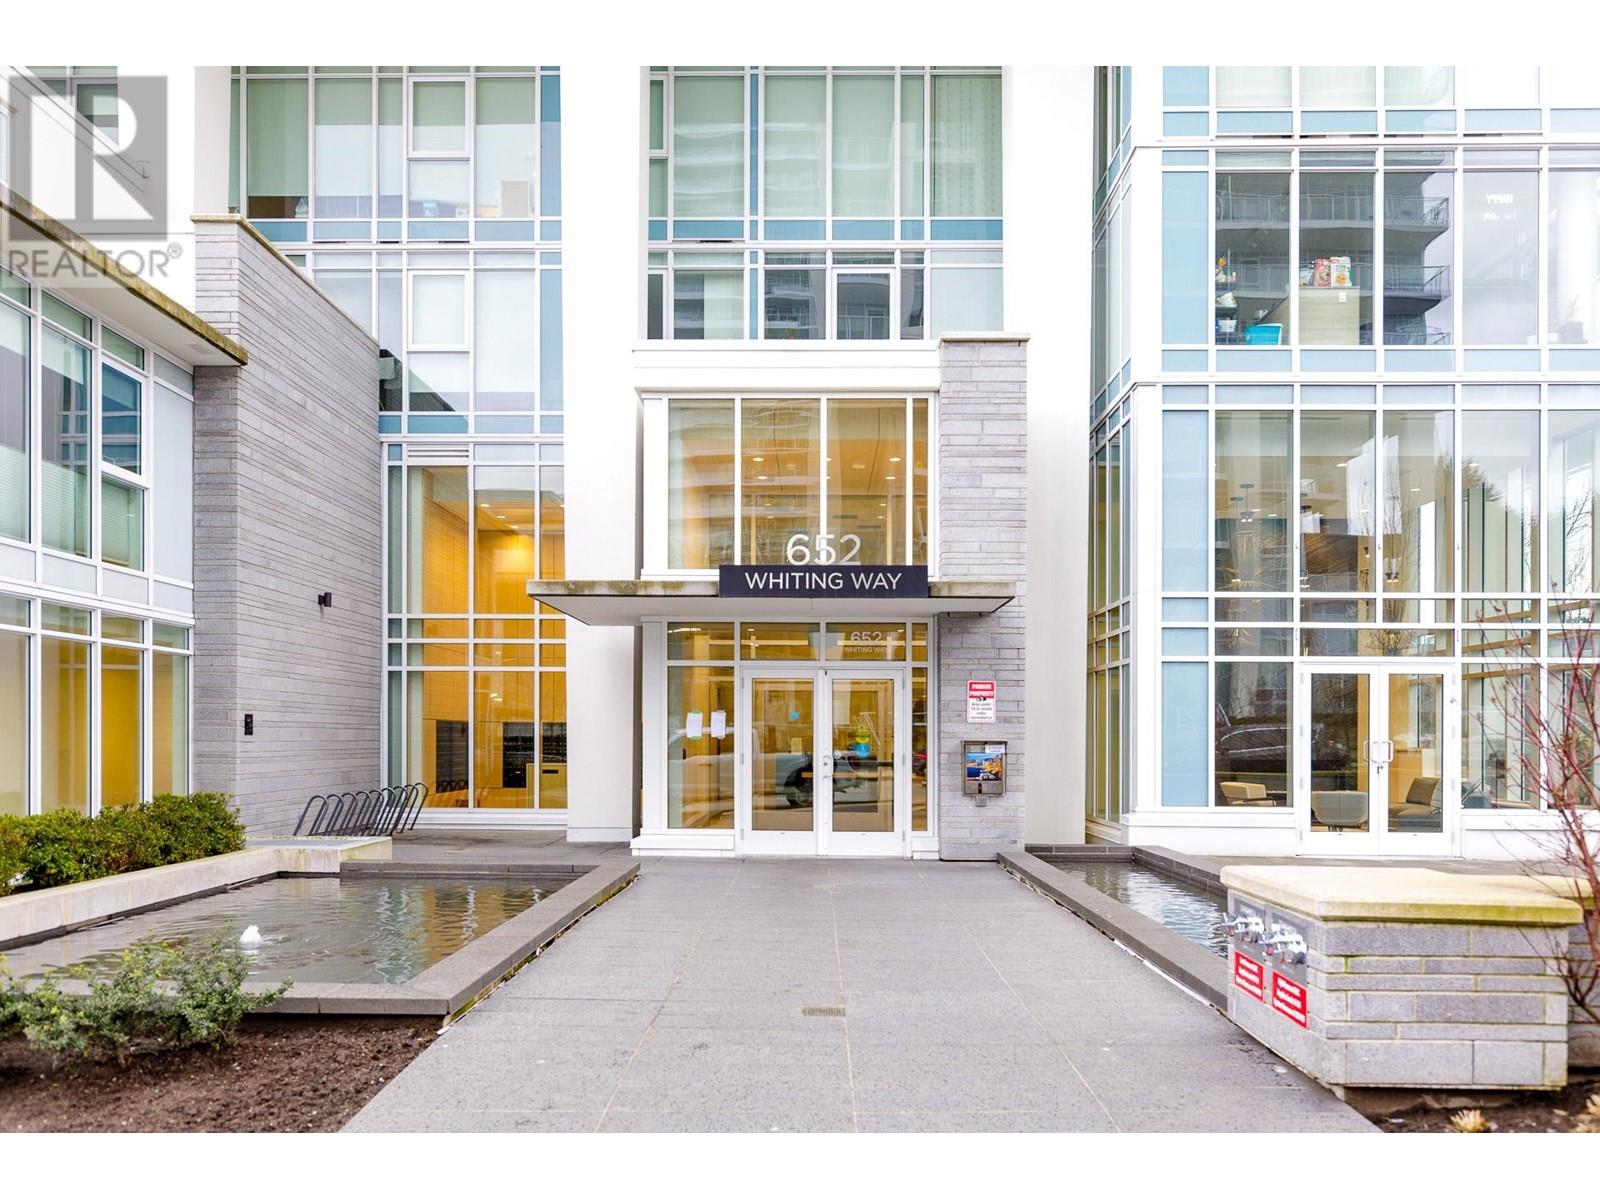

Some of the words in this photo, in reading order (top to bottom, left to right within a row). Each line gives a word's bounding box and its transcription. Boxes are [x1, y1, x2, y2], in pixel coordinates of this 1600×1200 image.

[786, 534, 861, 566] 652
[745, 572, 843, 590] WHITING
[850, 572, 902, 590] WAY
[850, 631, 882, 645] 652
